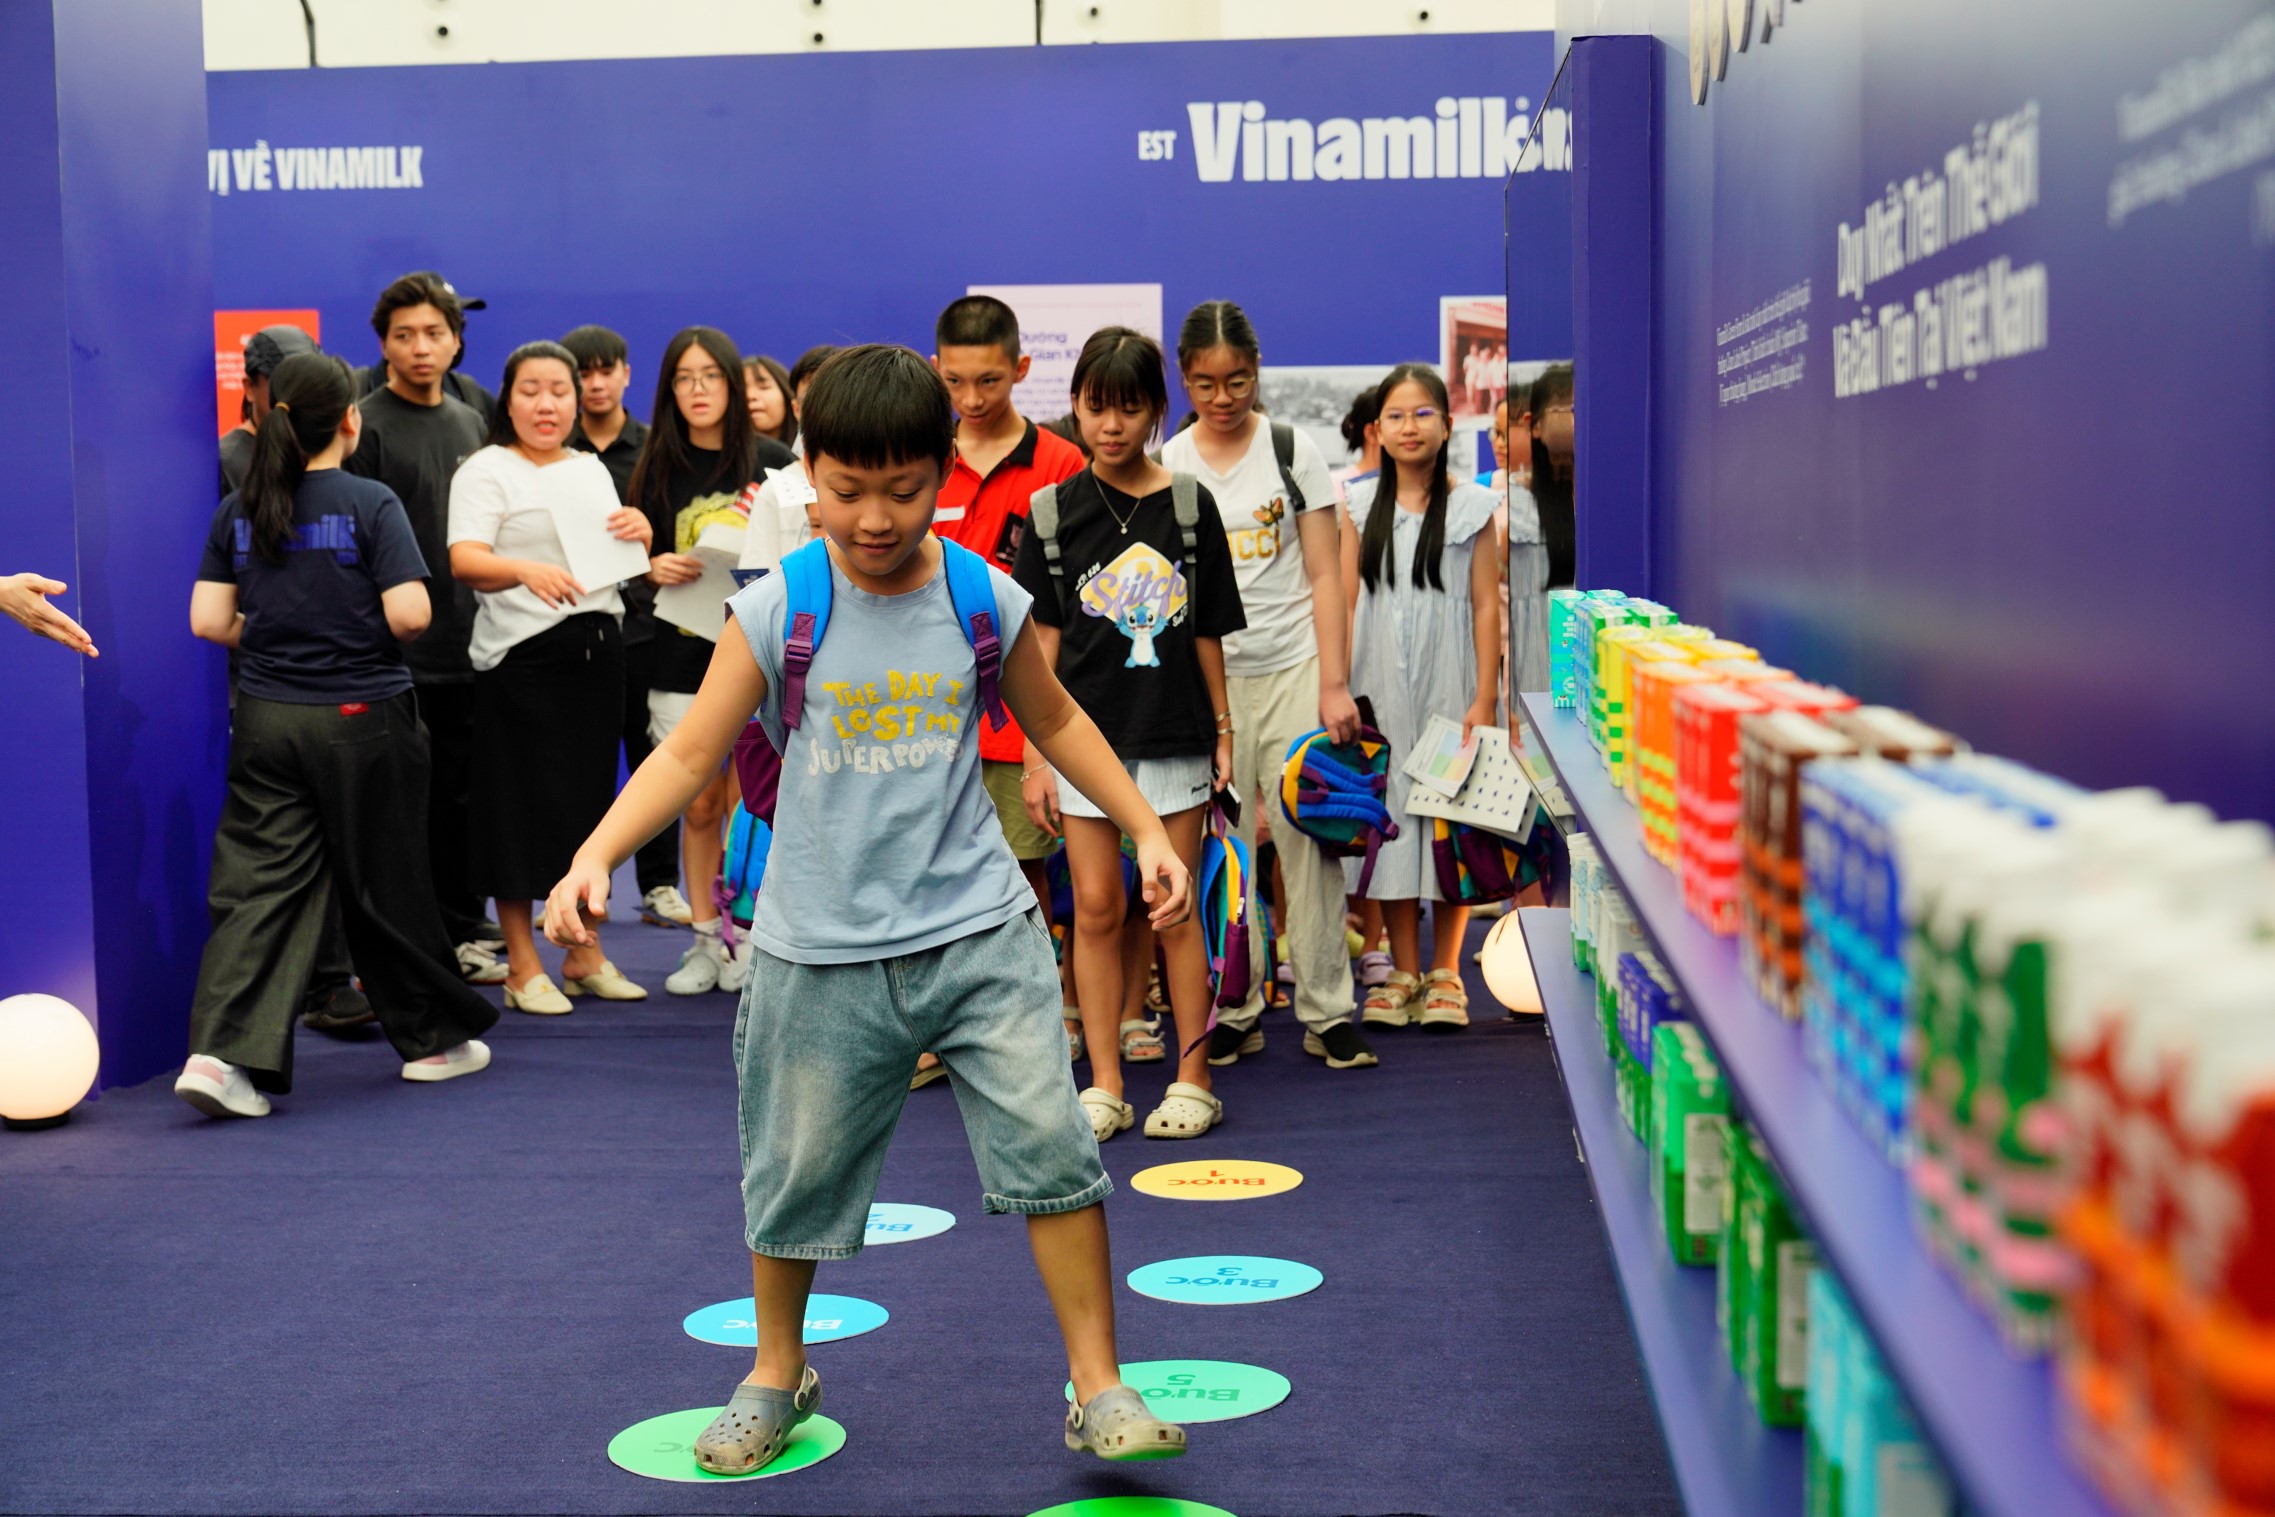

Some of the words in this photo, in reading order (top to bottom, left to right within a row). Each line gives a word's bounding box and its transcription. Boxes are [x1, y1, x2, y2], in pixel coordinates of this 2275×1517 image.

[1138, 131, 1177, 160] EST
[1187, 96, 1531, 182] Vinamilk
[231, 139, 272, 191] VỀ
[274, 146, 424, 190] VINAMILK
[1081, 559, 1188, 621] Stitch
[822, 682, 881, 707] THE
[887, 669, 942, 701] DAY
[944, 679, 964, 706] I
[831, 705, 923, 741] LOST
[926, 712, 960, 733] MY
[1216, 1267, 1243, 1276] 3
[1140, 1388, 1241, 1401] Bướ
[1167, 1374, 1196, 1386] 5
